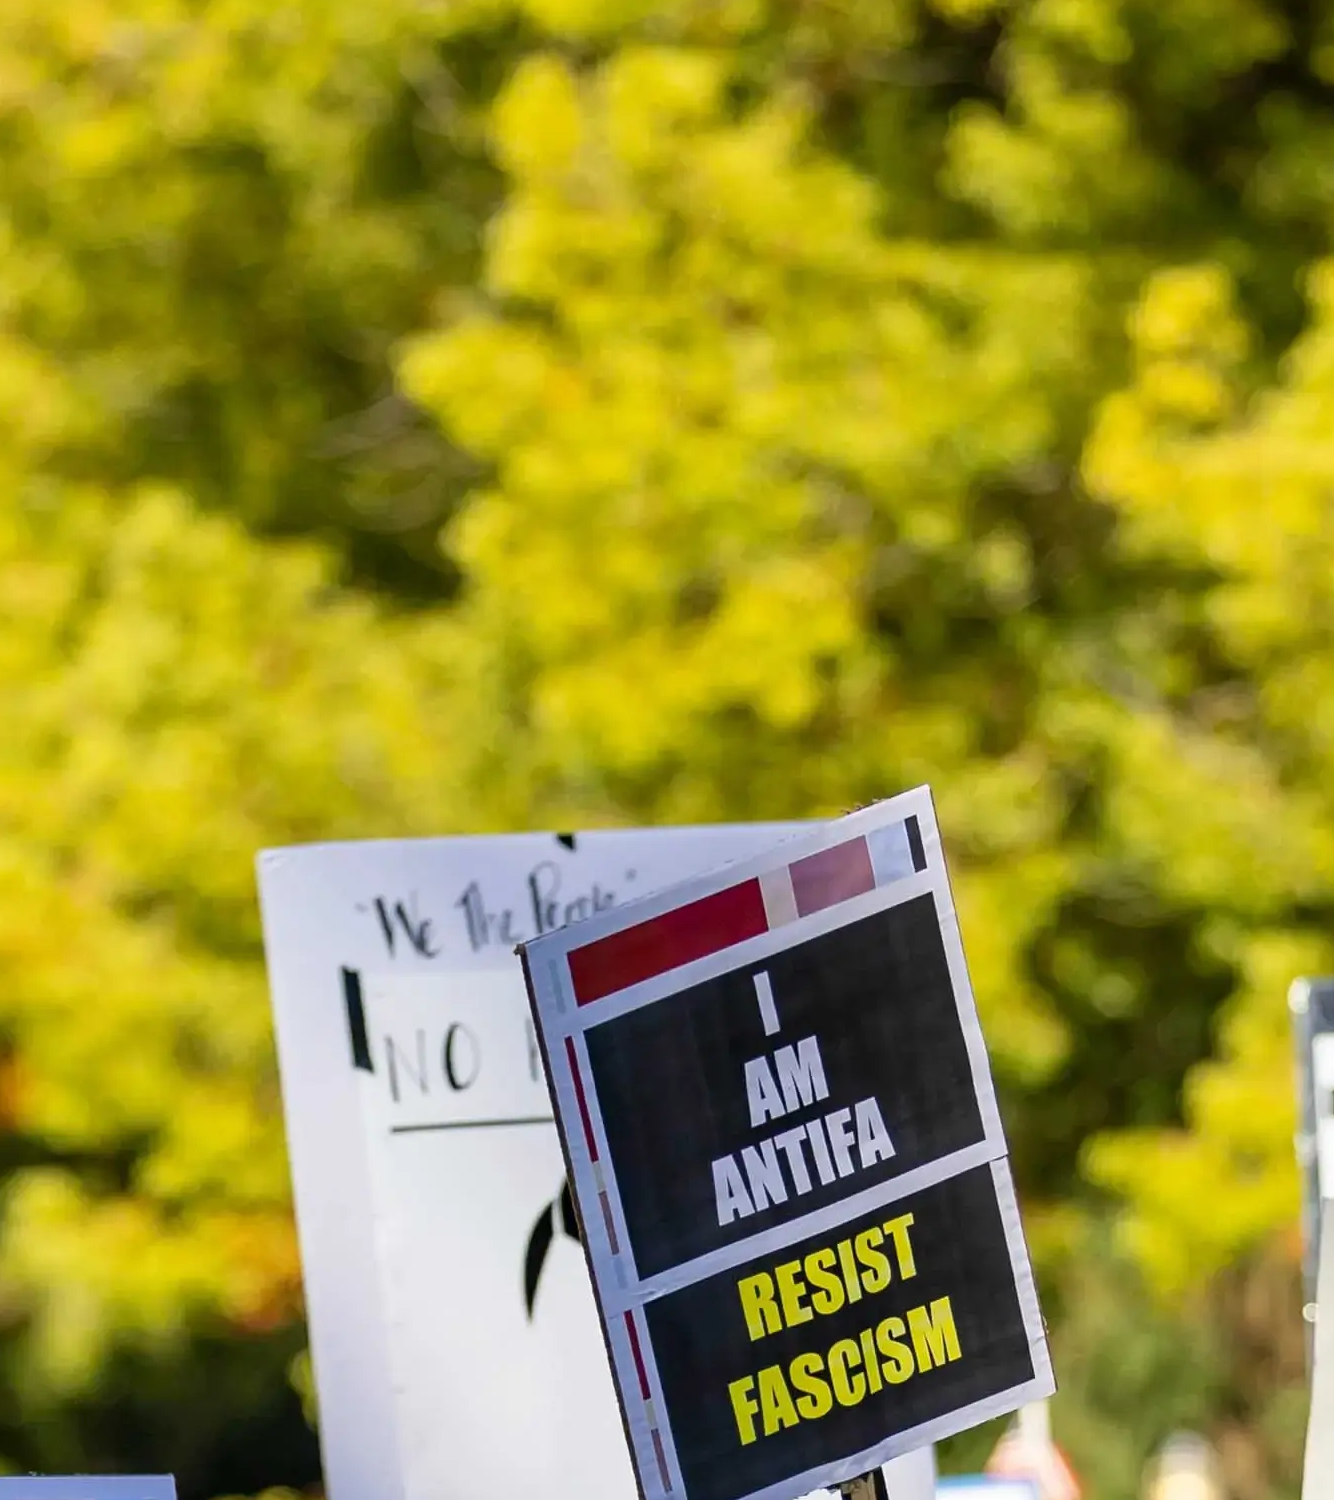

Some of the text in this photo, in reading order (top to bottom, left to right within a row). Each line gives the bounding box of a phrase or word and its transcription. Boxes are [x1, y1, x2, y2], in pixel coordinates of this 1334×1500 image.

[753, 970, 781, 1036] I
[383, 1021, 481, 1104] NO
[743, 1035, 830, 1128] AM
[711, 1096, 896, 1227] ANTIFA
[737, 1212, 918, 1342] RESIST
[727, 1295, 962, 1446] FASCISM
